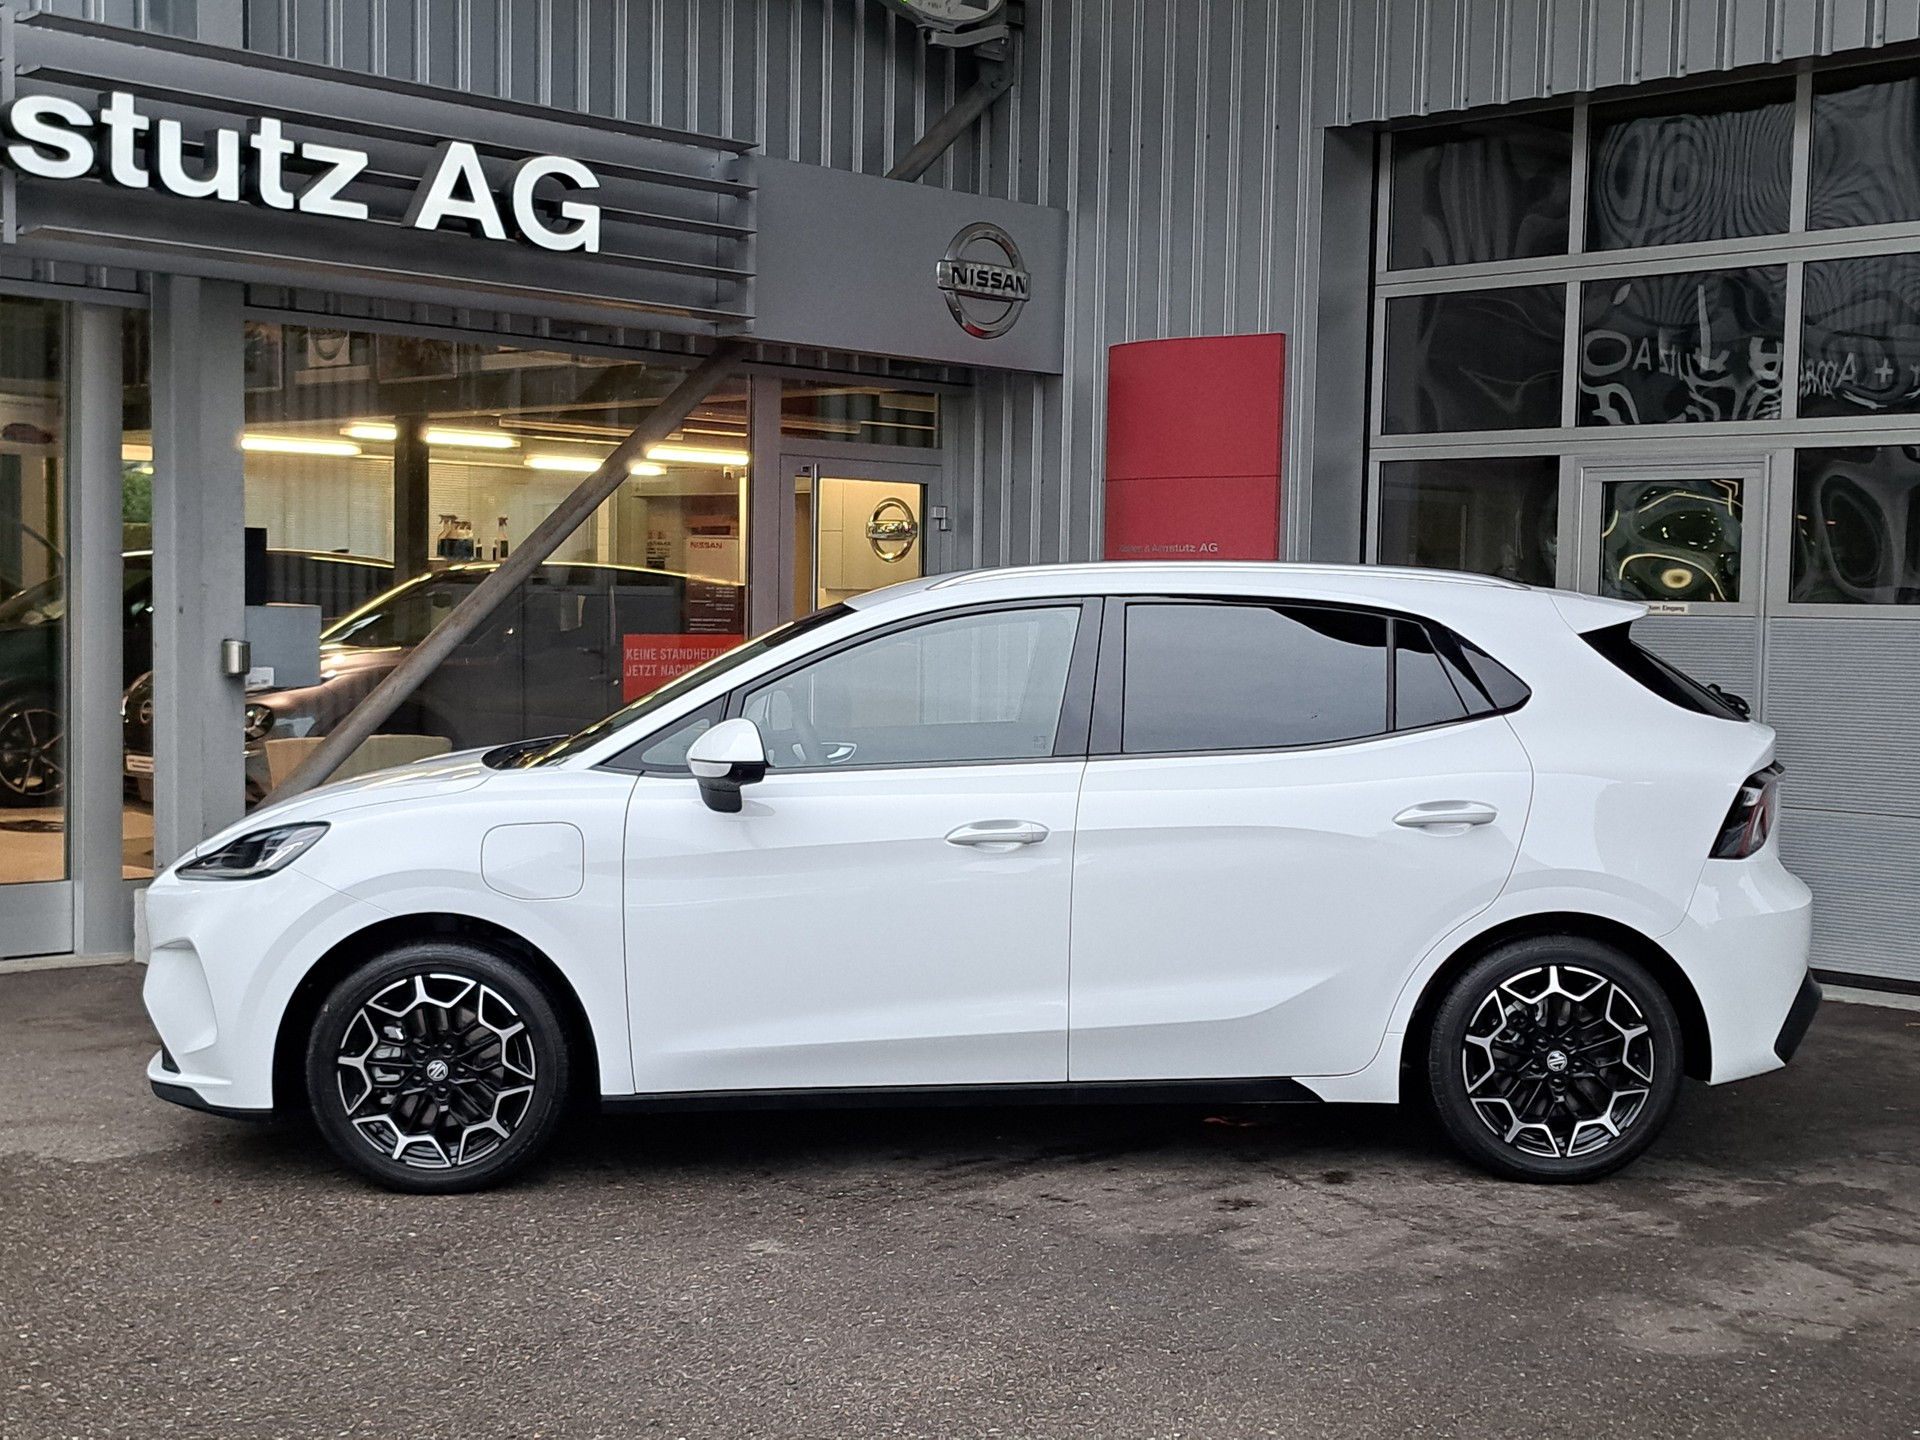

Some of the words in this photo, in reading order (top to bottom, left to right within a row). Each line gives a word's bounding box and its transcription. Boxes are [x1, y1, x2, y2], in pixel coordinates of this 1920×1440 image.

[7, 91, 369, 219] stutz
[414, 141, 601, 253] AG
[951, 266, 1028, 294] NISSAN
[689, 541, 723, 549] NISSAN
[1199, 542, 1218, 553] AG
[625, 648, 657, 661] KEINE
[625, 664, 657, 677] JETZT
